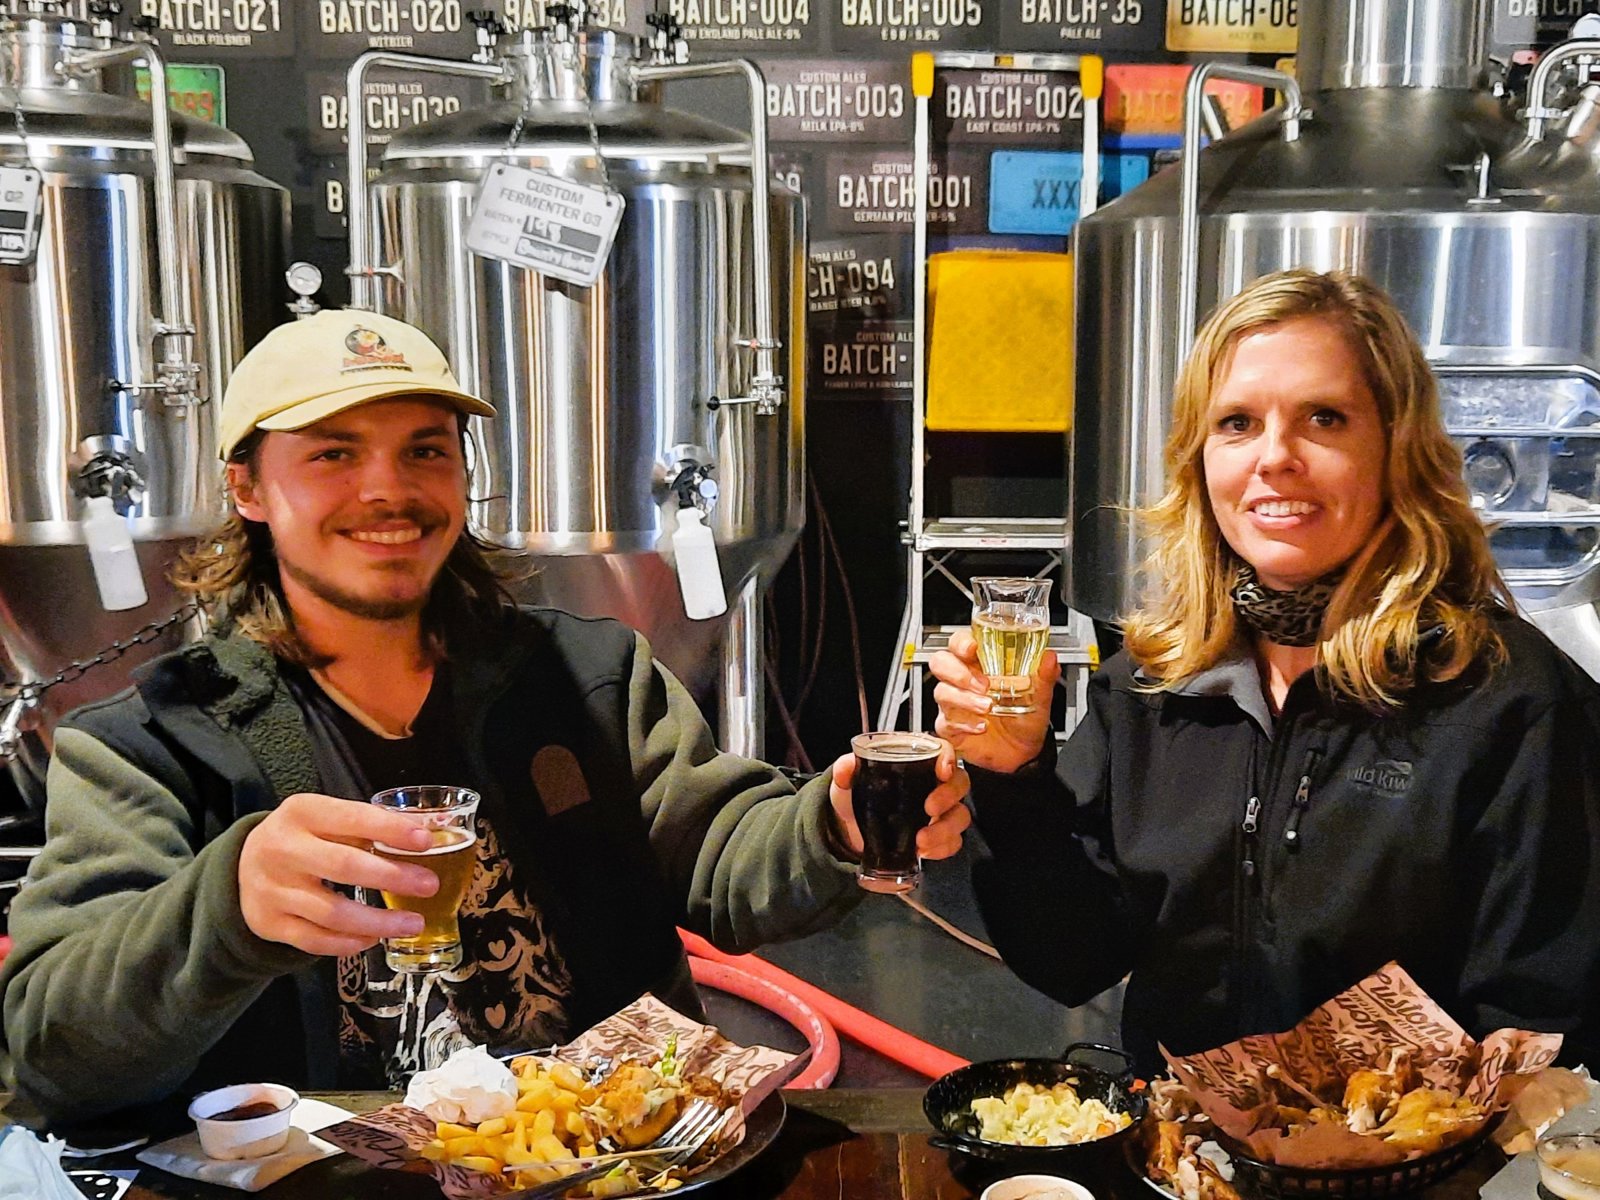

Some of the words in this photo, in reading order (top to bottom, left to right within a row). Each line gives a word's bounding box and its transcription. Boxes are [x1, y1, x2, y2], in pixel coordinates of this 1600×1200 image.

[1060, 27, 1082, 39] PALE
[1085, 28, 1102, 39] ALE
[173, 33, 206, 45] BLACK
[207, 33, 251, 45] PILSNER
[368, 35, 414, 48] WITBIER
[800, 72, 840, 83] CUSTOM
[843, 72, 867, 83] ALES
[981, 73, 1022, 84] CUSTOM
[1024, 74, 1048, 84] ALES
[399, 83, 423, 94] ALES
[966, 122, 990, 133] EAST
[993, 122, 1022, 133] COAST
[872, 163, 912, 174] CUSTOM
[526, 179, 584, 204] CUSTOM
[499, 188, 581, 221] FERMENTER
[854, 211, 895, 222] GERMAN
[833, 250, 856, 262] ALES
[898, 333, 914, 343] ALE
